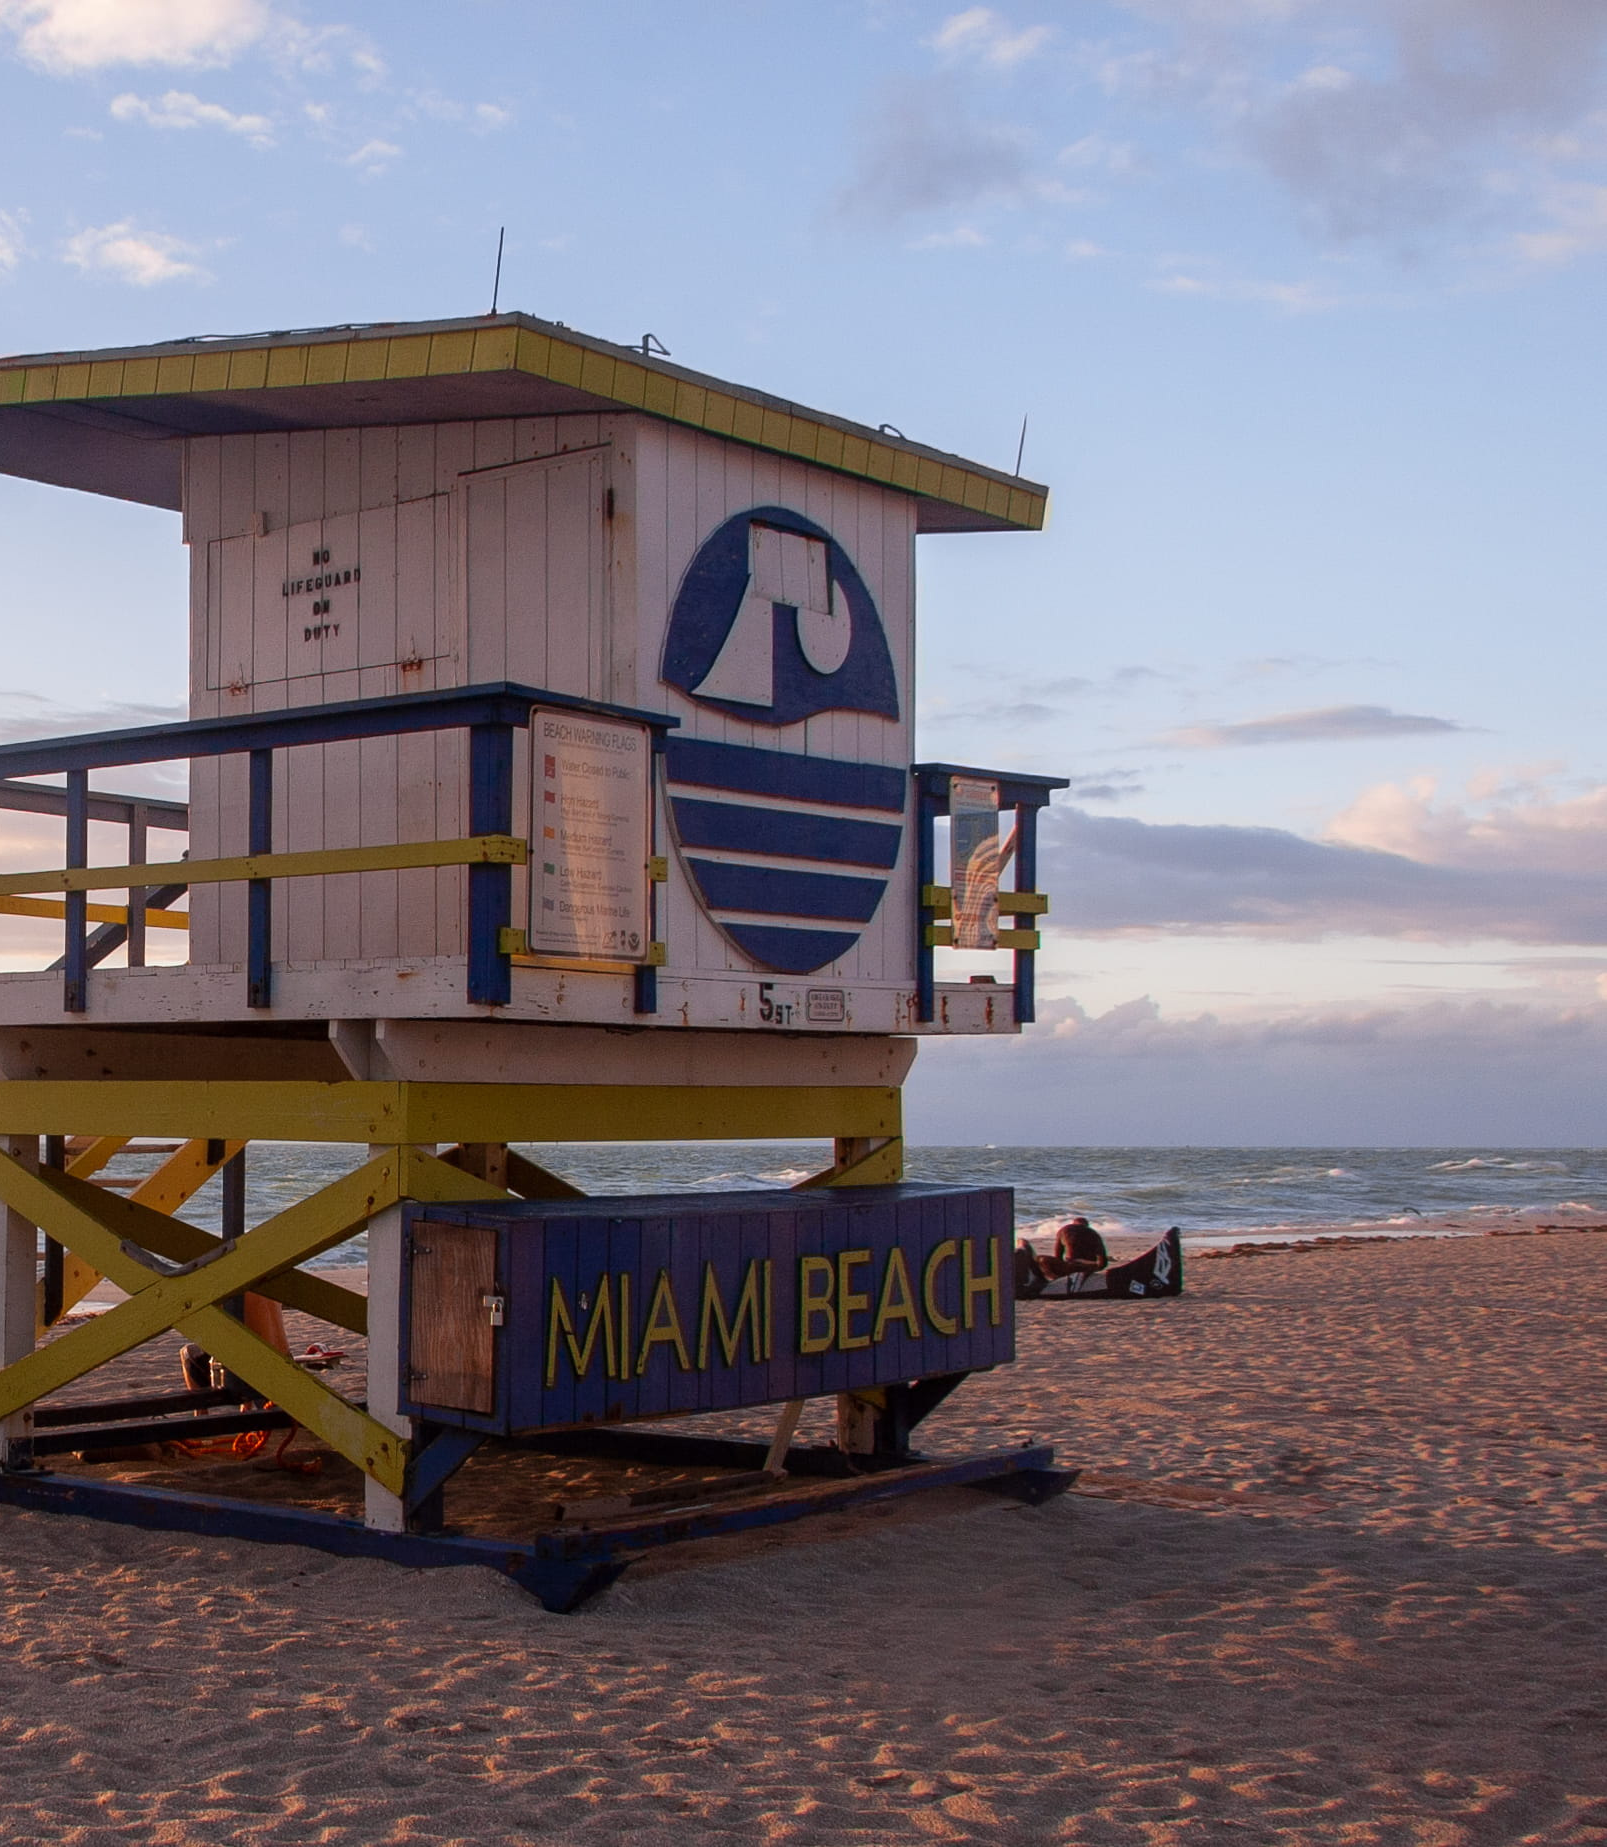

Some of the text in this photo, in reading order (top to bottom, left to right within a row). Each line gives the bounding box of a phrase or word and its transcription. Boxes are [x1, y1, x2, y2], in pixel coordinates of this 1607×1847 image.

[312, 550, 330, 566] NO
[282, 568, 361, 597] LIFEGUARD
[312, 600, 330, 616] ON
[304, 624, 340, 642] DUTY
[544, 722, 572, 740] BEACH
[574, 728, 610, 747] WARNING
[612, 733, 637, 752] FLAGS
[561, 759, 580, 772] Water
[581, 761, 603, 775] Closed
[559, 901, 595, 915] Dangerous
[545, 1236, 1002, 1388] MIAMI BEACH
